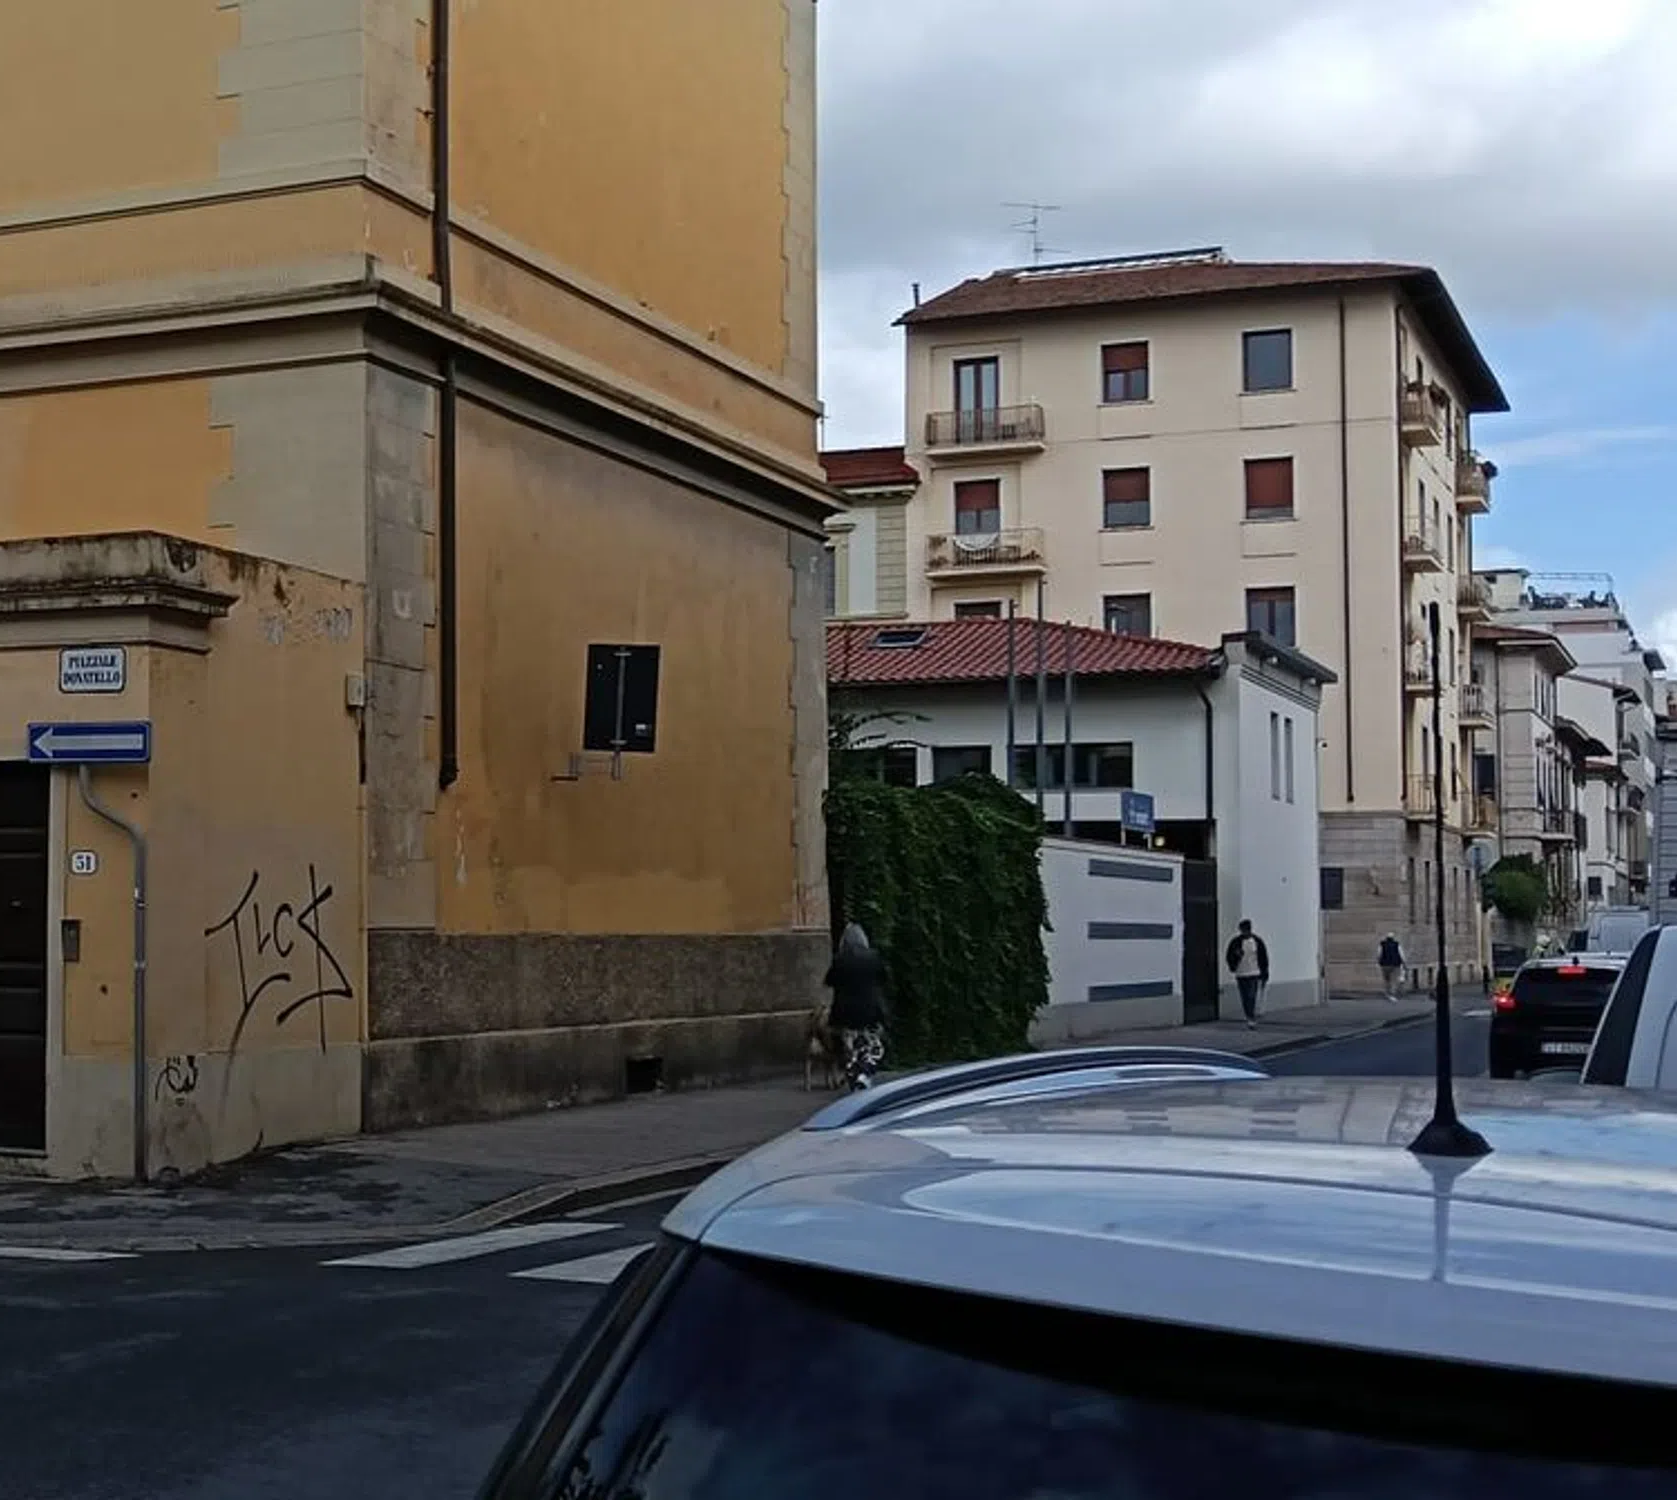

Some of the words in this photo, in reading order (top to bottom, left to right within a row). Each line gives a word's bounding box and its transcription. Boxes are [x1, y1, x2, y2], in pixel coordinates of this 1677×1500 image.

[68, 654, 117, 668] PIAZZALE
[63, 671, 121, 685] DONATELLO
[75, 855, 93, 871] 51
